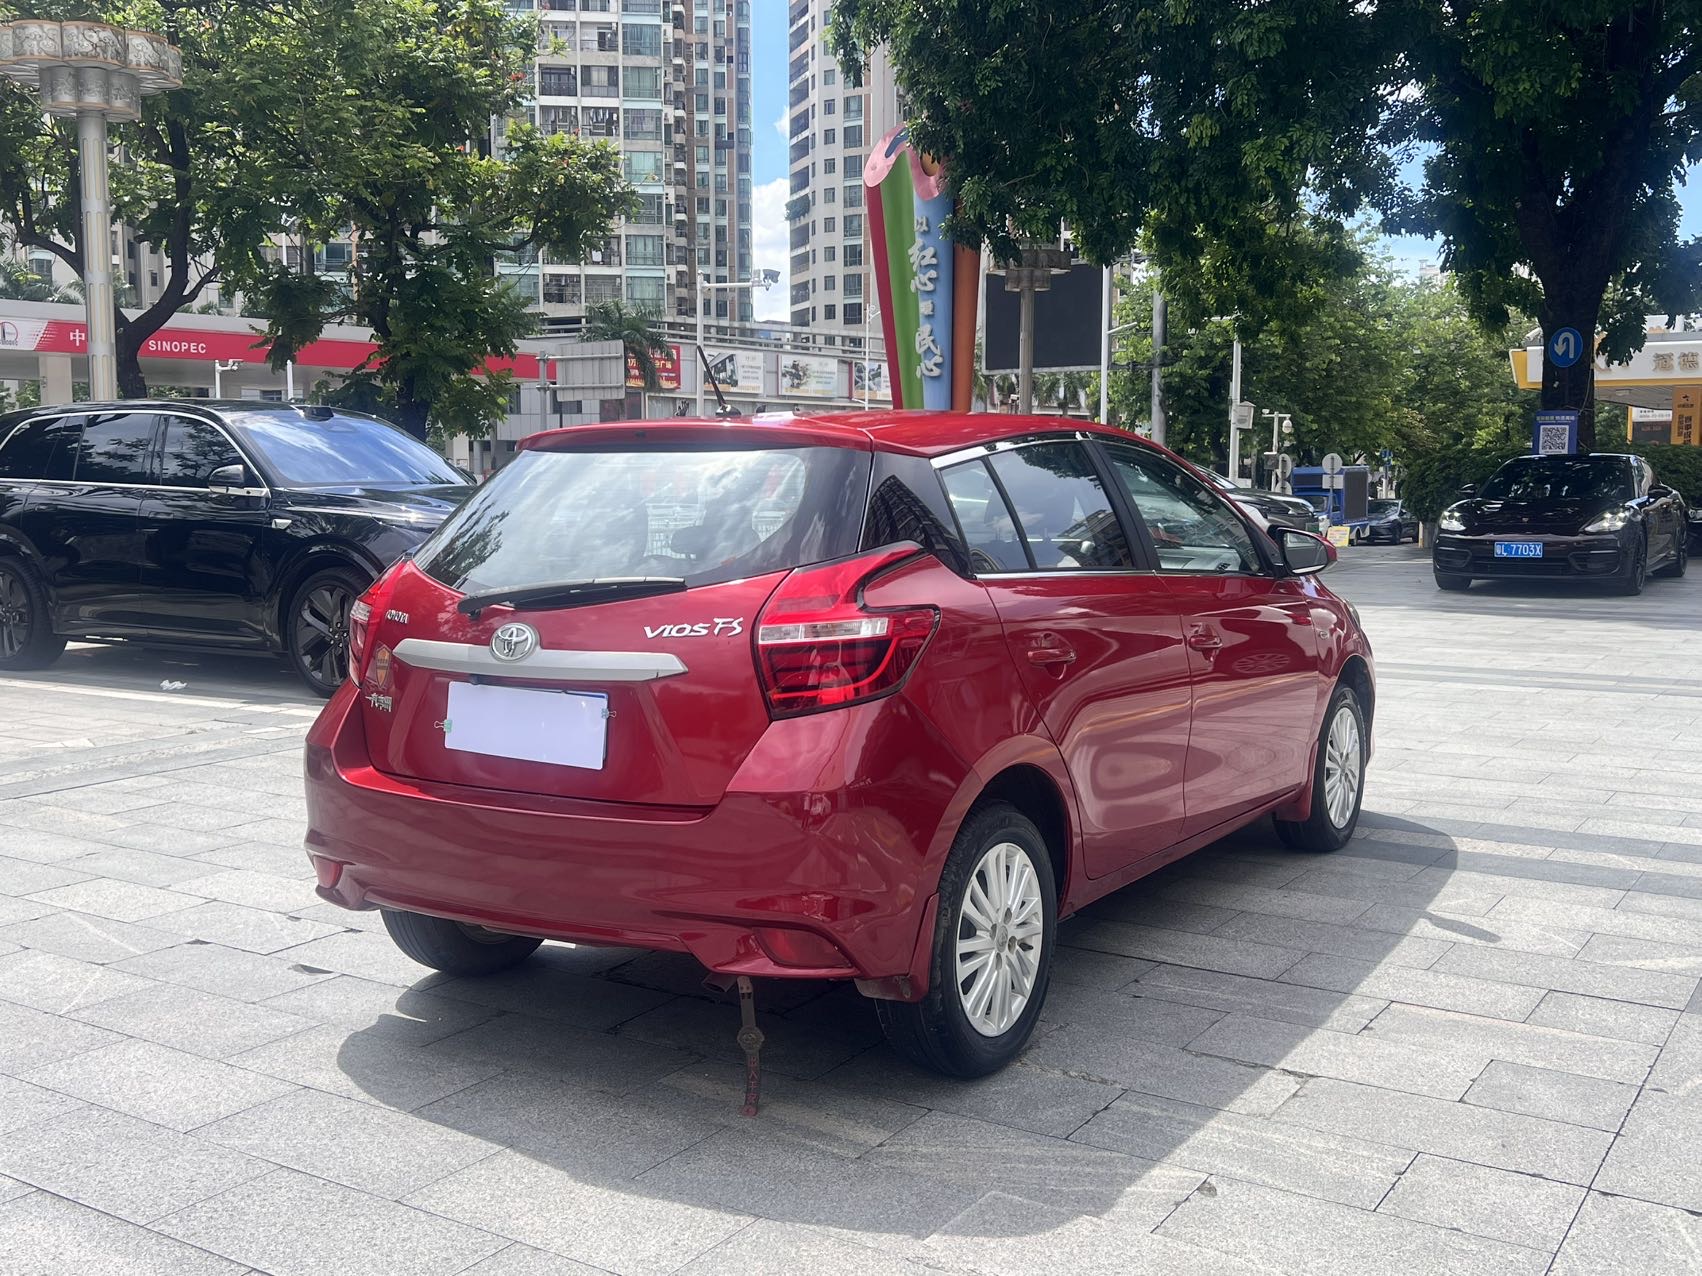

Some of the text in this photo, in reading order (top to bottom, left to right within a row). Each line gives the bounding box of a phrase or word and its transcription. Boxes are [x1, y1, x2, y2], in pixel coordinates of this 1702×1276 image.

[69, 328, 86, 347] 中
[148, 339, 207, 354] SINOPEC
[643, 617, 744, 639] VIOS FS
